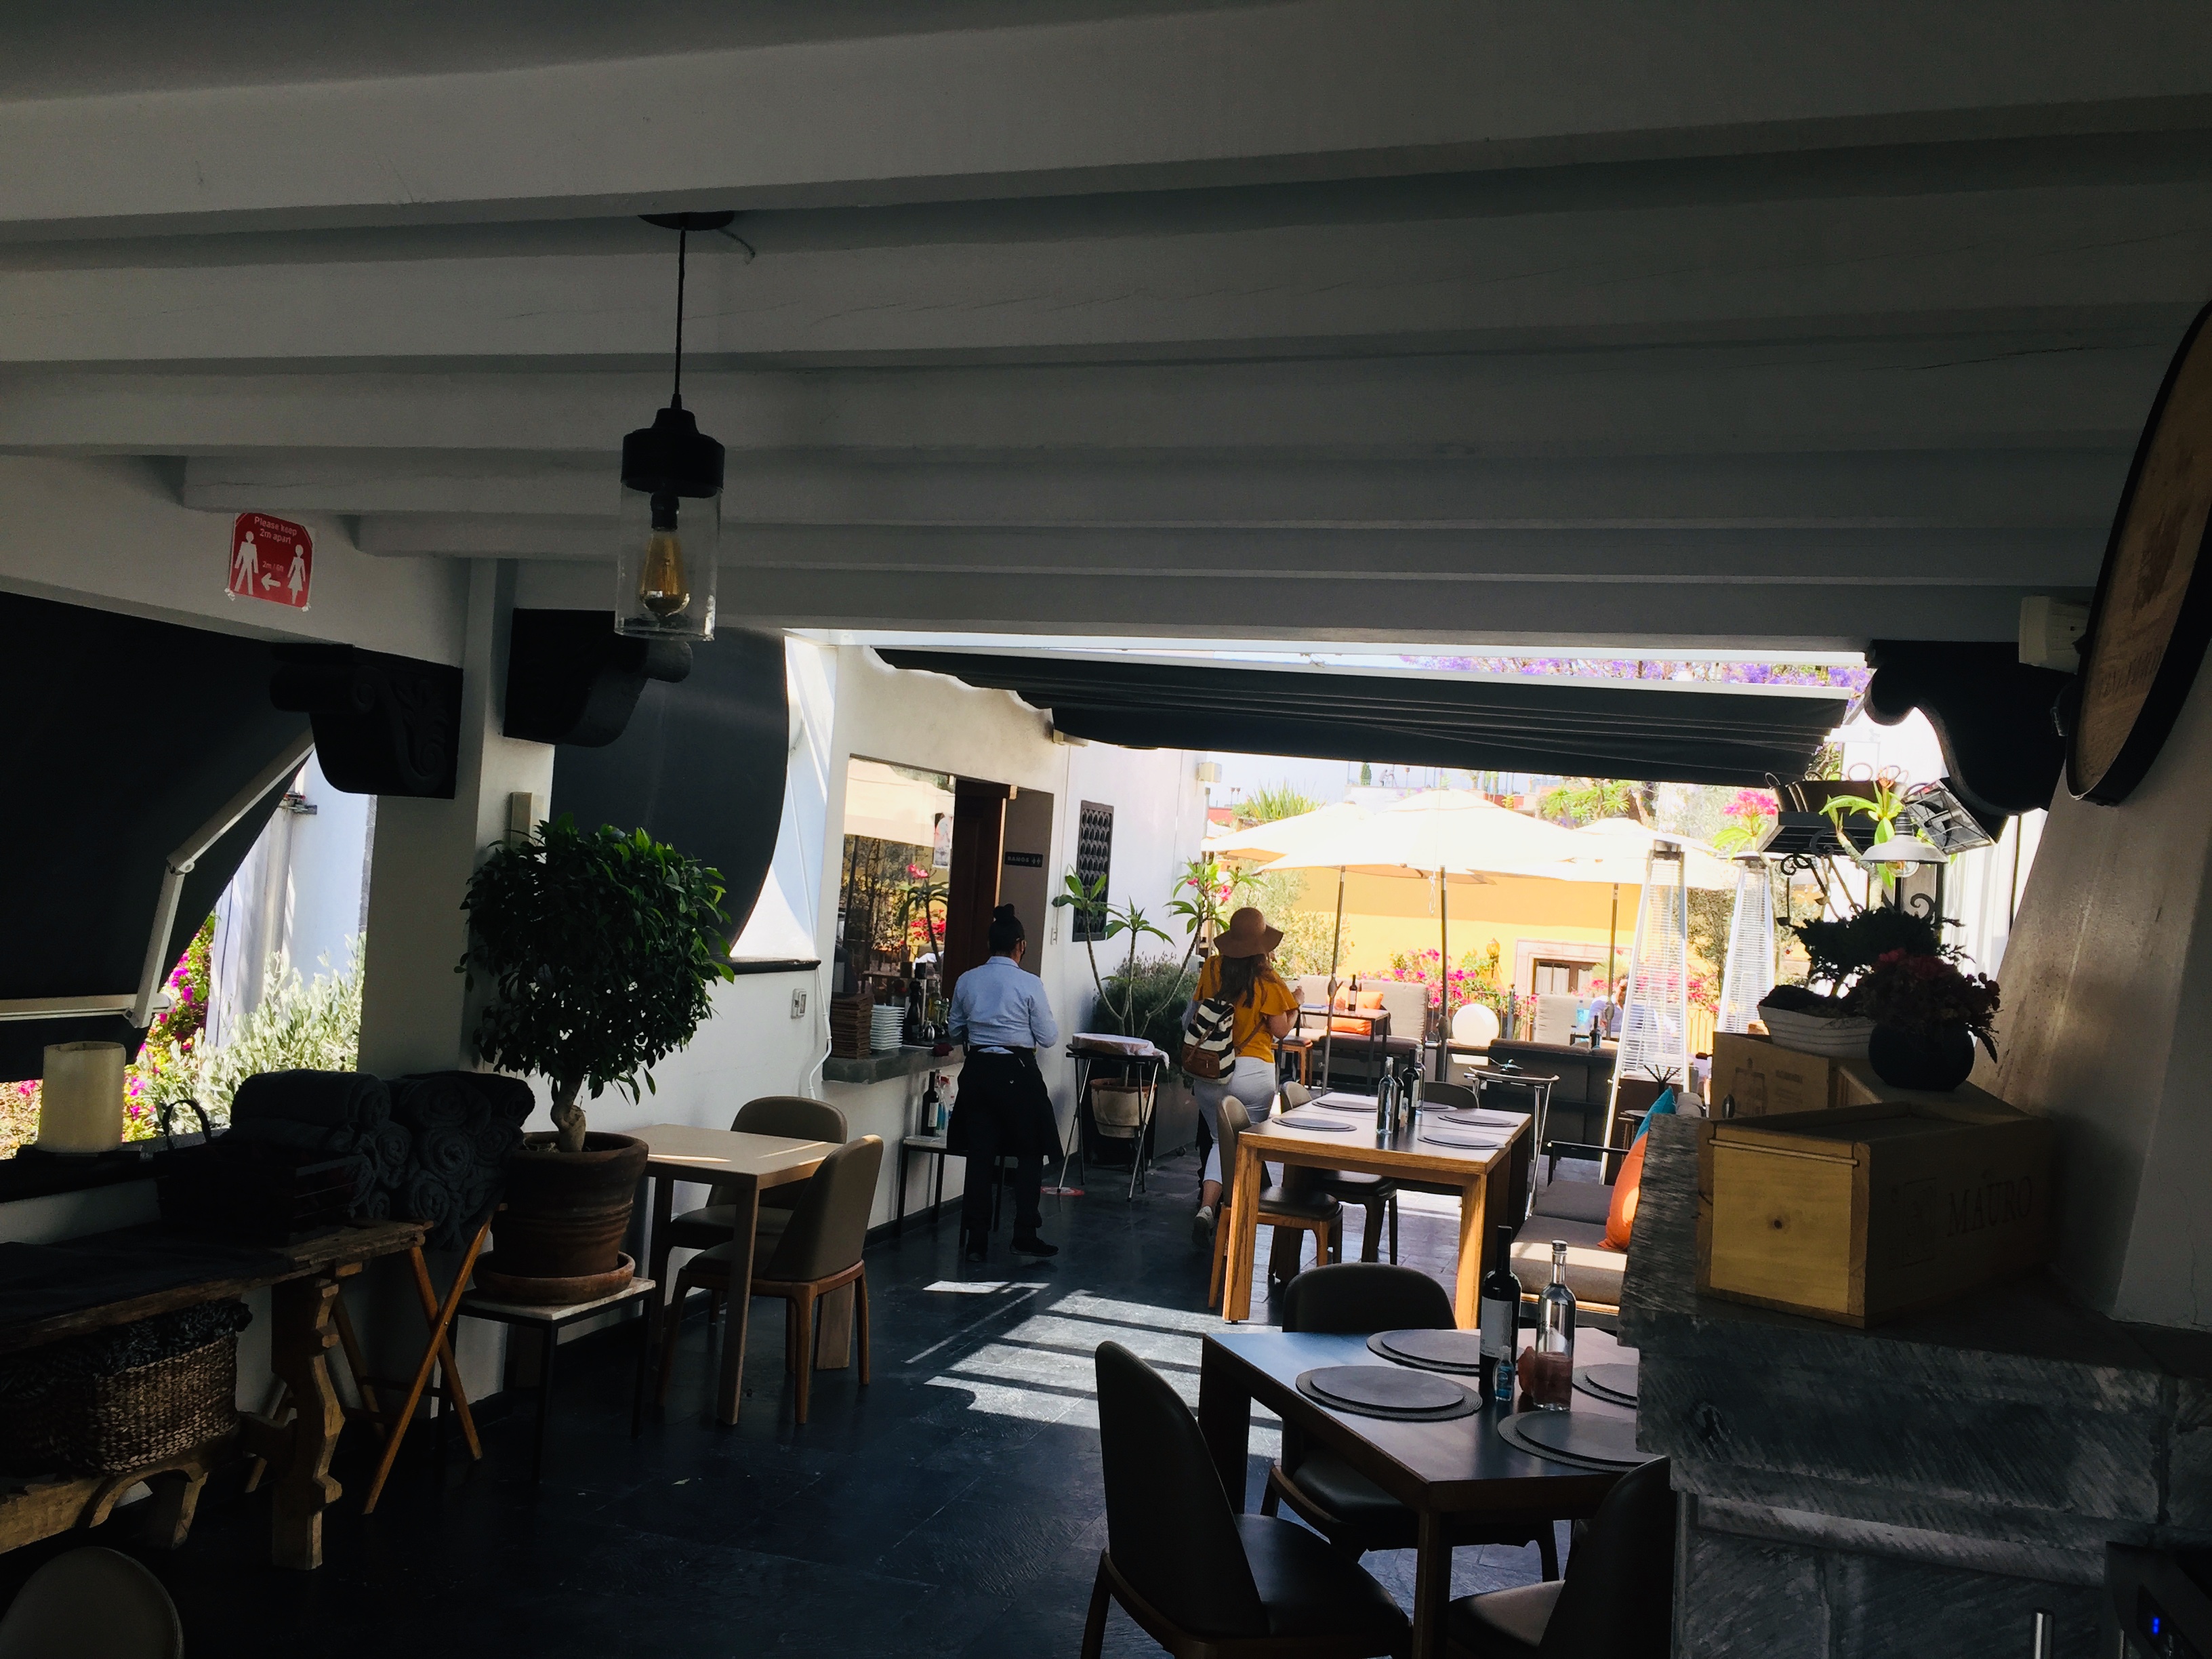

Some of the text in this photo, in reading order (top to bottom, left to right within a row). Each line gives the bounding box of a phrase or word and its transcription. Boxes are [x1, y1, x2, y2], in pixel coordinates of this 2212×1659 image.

[254, 516, 297, 536] Please keep
[260, 529, 291, 544] 2m apart
